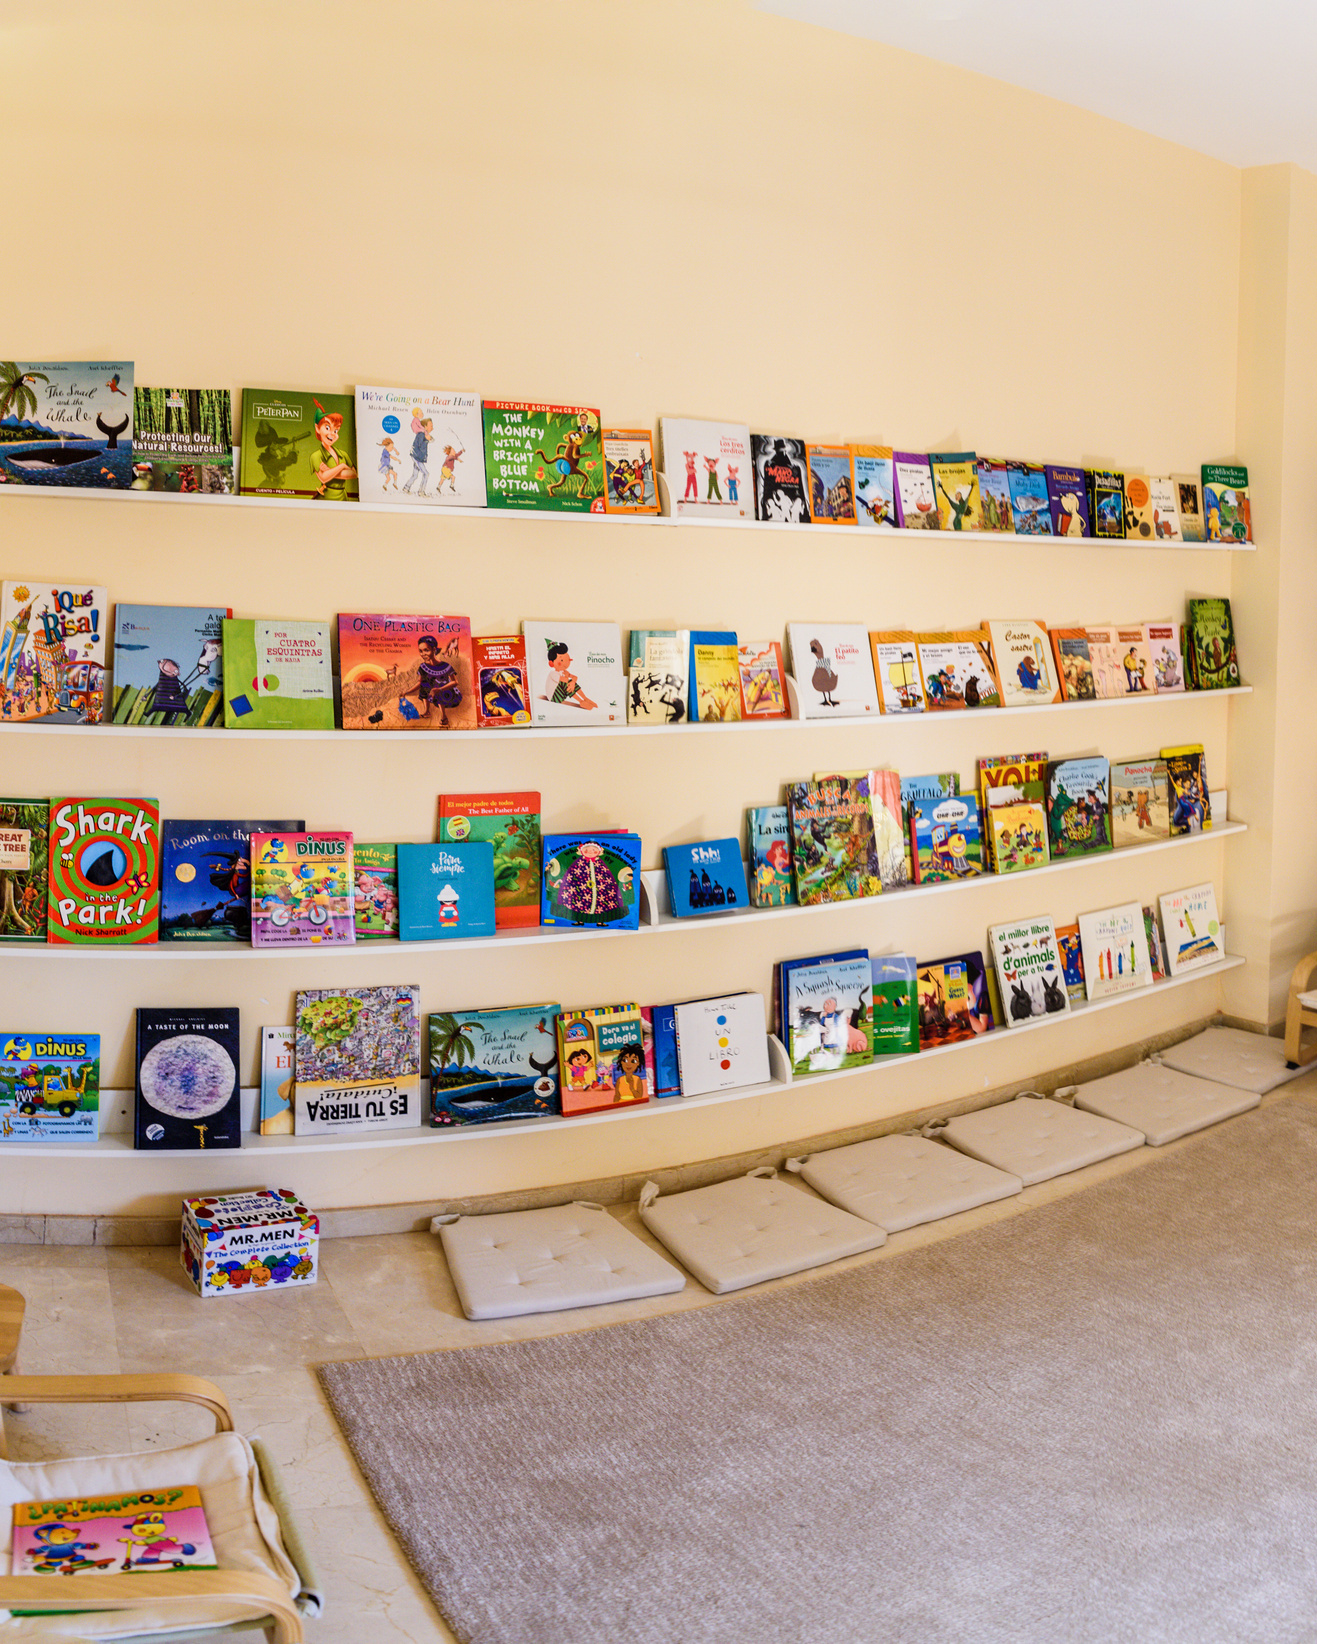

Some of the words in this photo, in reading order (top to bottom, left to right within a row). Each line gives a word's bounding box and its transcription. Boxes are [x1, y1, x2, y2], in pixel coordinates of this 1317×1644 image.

[45, 383, 64, 399] The
[66, 383, 98, 398] Snail
[362, 391, 383, 402] We're
[386, 392, 411, 406] Going
[432, 396, 451, 406] Bear
[454, 397, 474, 406] Hunt
[496, 402, 528, 410] PICTURE
[46, 407, 92, 422] Whale
[503, 414, 522, 423] THE
[140, 430, 190, 444] Protecting
[194, 432, 212, 443] Our
[492, 422, 544, 440] MONKEY
[132, 440, 168, 452] Natural
[170, 443, 222, 453] Resources!
[494, 438, 521, 448] WITH
[524, 440, 532, 450] A
[720, 446, 745, 456] cerditos
[493, 450, 534, 463] BRIGHT
[500, 464, 528, 478] BLUE
[492, 478, 540, 493] BOTTOM
[1230, 477, 1246, 485] Bears
[52, 588, 94, 613] ¡Qué
[43, 609, 100, 645] Risa!
[353, 618, 380, 632] ONE
[384, 620, 434, 632] PLASTIC
[438, 621, 461, 633] BAG
[1004, 630, 1030, 641] Castor
[266, 648, 322, 656] ESQUINITAS
[698, 648, 714, 656] Danny
[841, 647, 860, 656] patito
[1010, 644, 1032, 652] sastre
[586, 656, 614, 664] Pinocho
[984, 763, 1044, 788] YOU
[808, 785, 852, 806] BUSCA
[901, 788, 942, 800] GRUFFALO
[795, 807, 832, 820] ANIMALES
[56, 804, 154, 847] Shark
[758, 824, 772, 835] La
[171, 834, 210, 850] Room
[213, 832, 230, 840] on
[296, 836, 346, 856] DINUS
[5, 844, 26, 853] TREE
[691, 846, 720, 861] Shh!
[439, 852, 462, 864] Para
[430, 863, 465, 876] Siempre
[86, 892, 96, 902] in
[98, 892, 118, 902] the
[58, 898, 146, 927] Park!
[76, 928, 93, 936] Nick
[95, 928, 128, 936] Sharratt
[999, 932, 1006, 942] el
[1008, 928, 1029, 940] millor
[1030, 924, 1050, 938] llibre
[1003, 948, 1056, 972] d'animals
[804, 976, 834, 995] Squash
[480, 1031, 498, 1045] The
[500, 1029, 528, 1044] Snail
[602, 1026, 620, 1035] Dora
[715, 1028, 732, 1036] UN
[880, 1026, 910, 1034] ovejitas
[36, 1037, 86, 1056] DINUS
[602, 1032, 638, 1047] colegio
[482, 1050, 524, 1066] Whale
[709, 1046, 741, 1061] LIBRO
[275, 1056, 291, 1068] El
[320, 1086, 397, 1101] ¡Cuídala!
[306, 1100, 361, 1122] TIERRA
[366, 1101, 386, 1118] TU
[389, 1094, 408, 1116] ES
[214, 1202, 282, 1214] Complete
[219, 1197, 268, 1207] Collection
[230, 1246, 270, 1257] Complete
[272, 1240, 309, 1251] Collection
[28, 1490, 184, 1520] ¿PATINAMOS?
